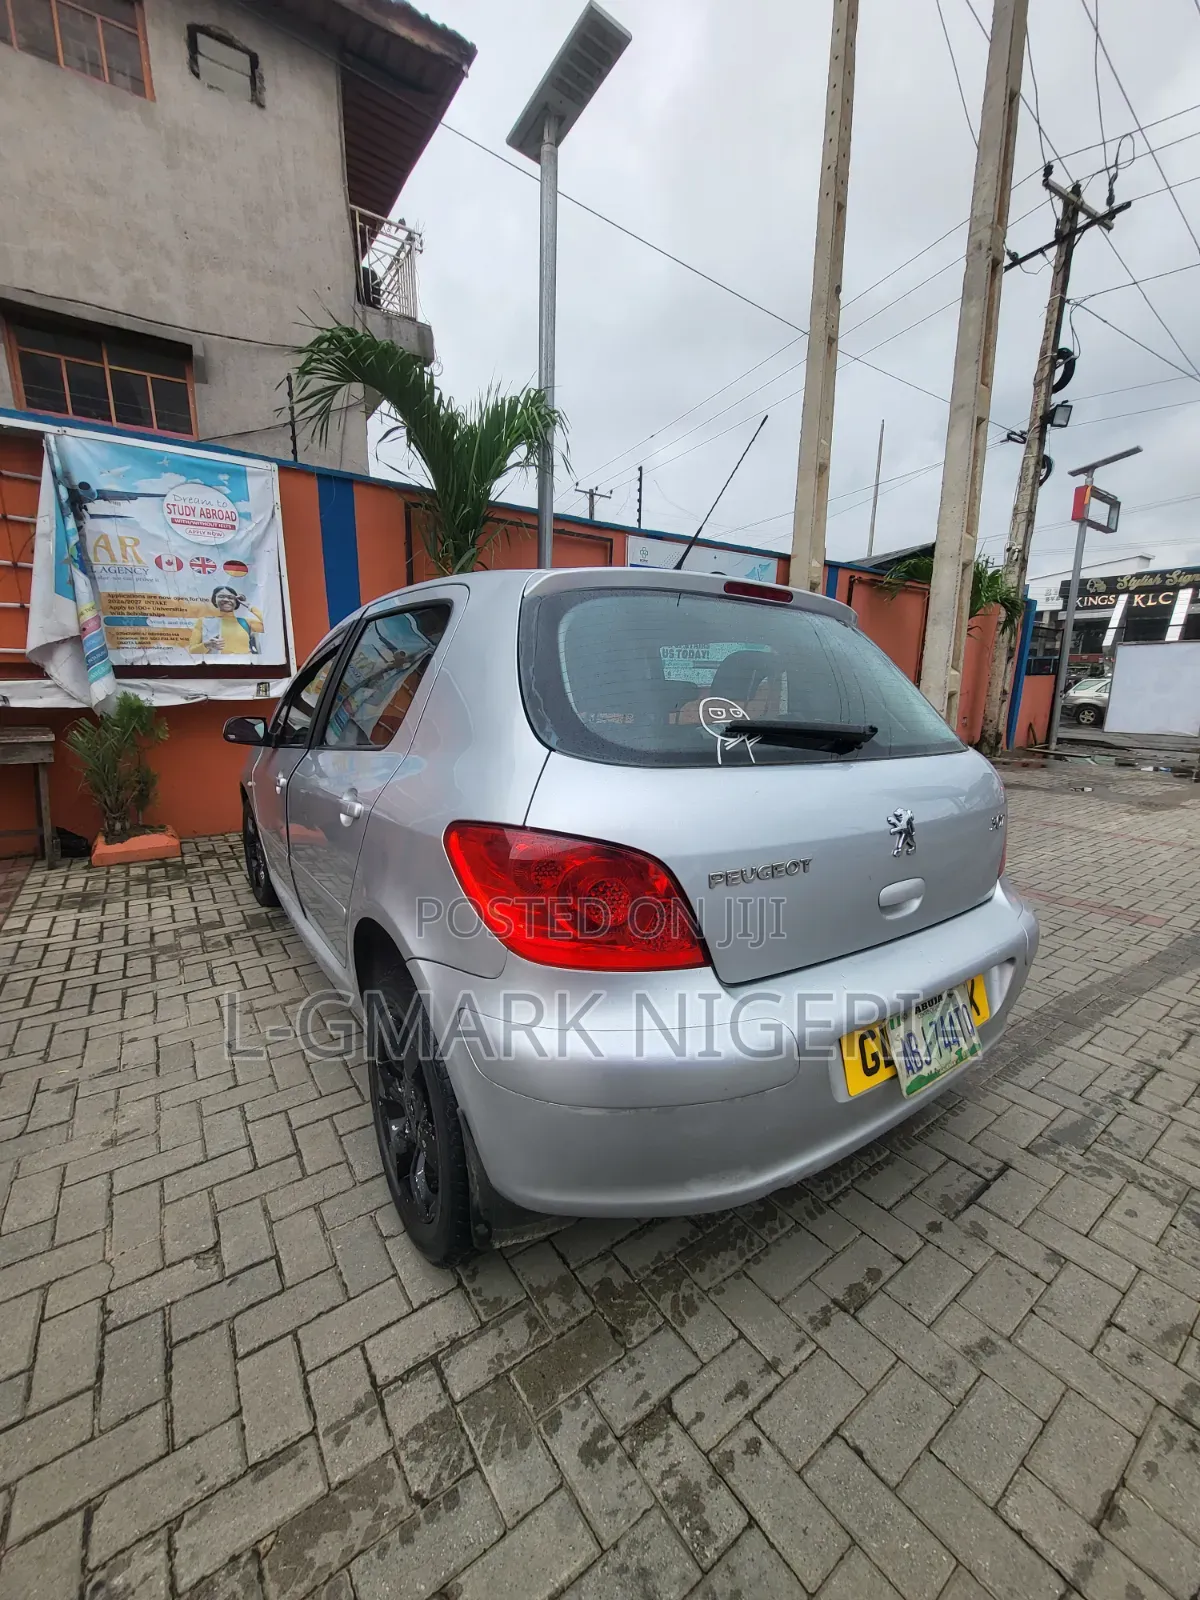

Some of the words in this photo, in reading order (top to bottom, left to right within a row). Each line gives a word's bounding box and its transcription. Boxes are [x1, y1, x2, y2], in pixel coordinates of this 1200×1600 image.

[173, 494, 213, 507] Dream
[216, 500, 228, 508] to
[166, 503, 196, 518] STUDY
[199, 507, 237, 522] ABROAD
[100, 566, 150, 576] AGENCY
[1116, 574, 1163, 591] Stylish
[1075, 594, 1116, 608] KINGS
[1133, 591, 1174, 608] KLC
[661, 648, 675, 659] US
[676, 649, 710, 660] TODAY!
[708, 857, 813, 890] PEUGEOT
[914, 993, 944, 1015] ABUJA
